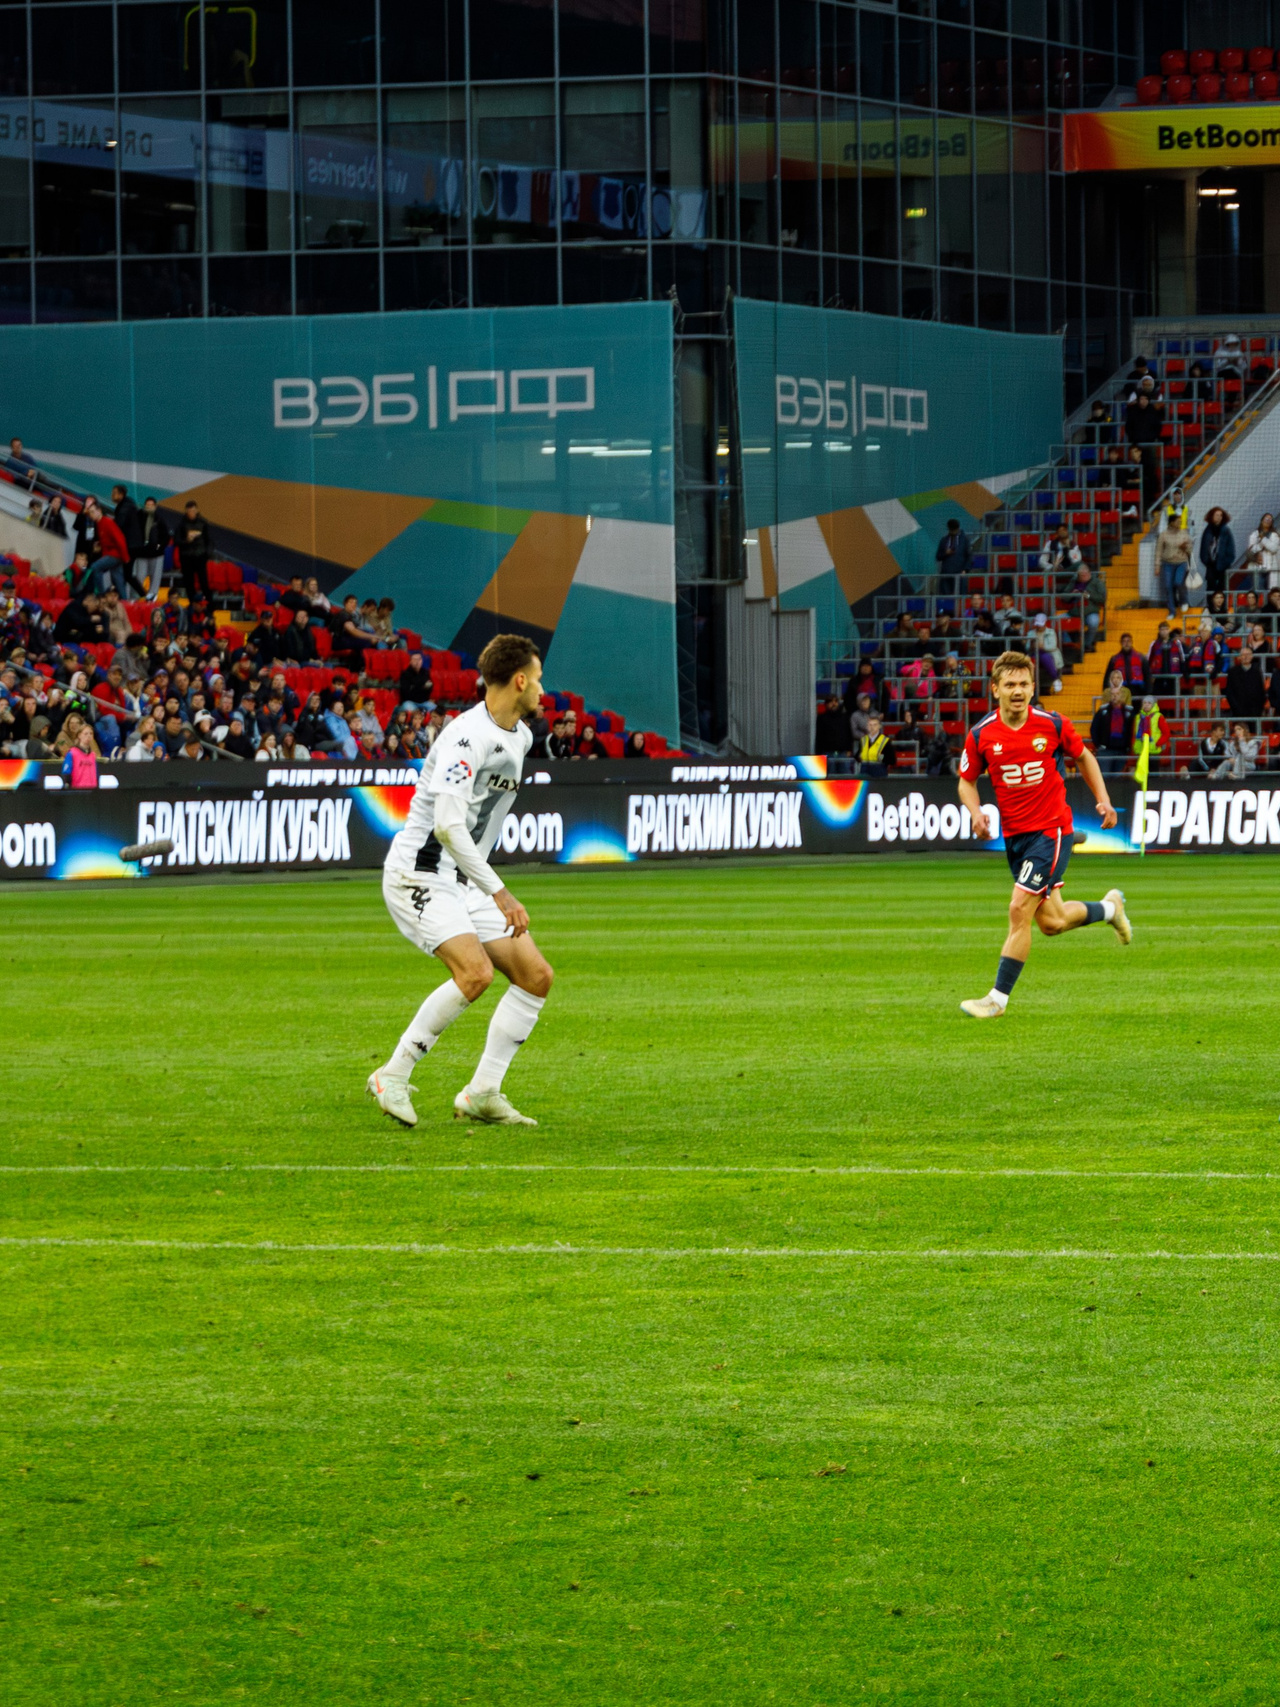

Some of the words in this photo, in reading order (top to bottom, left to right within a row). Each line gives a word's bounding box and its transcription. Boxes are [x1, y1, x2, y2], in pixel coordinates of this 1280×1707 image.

[1000, 760, 1046, 785] 25
[137, 790, 267, 867] БРАТСКИЙ
[269, 798, 352, 862] КУБОК
[627, 784, 732, 853] БРАТСКИЙ
[733, 791, 803, 849] КУБОК
